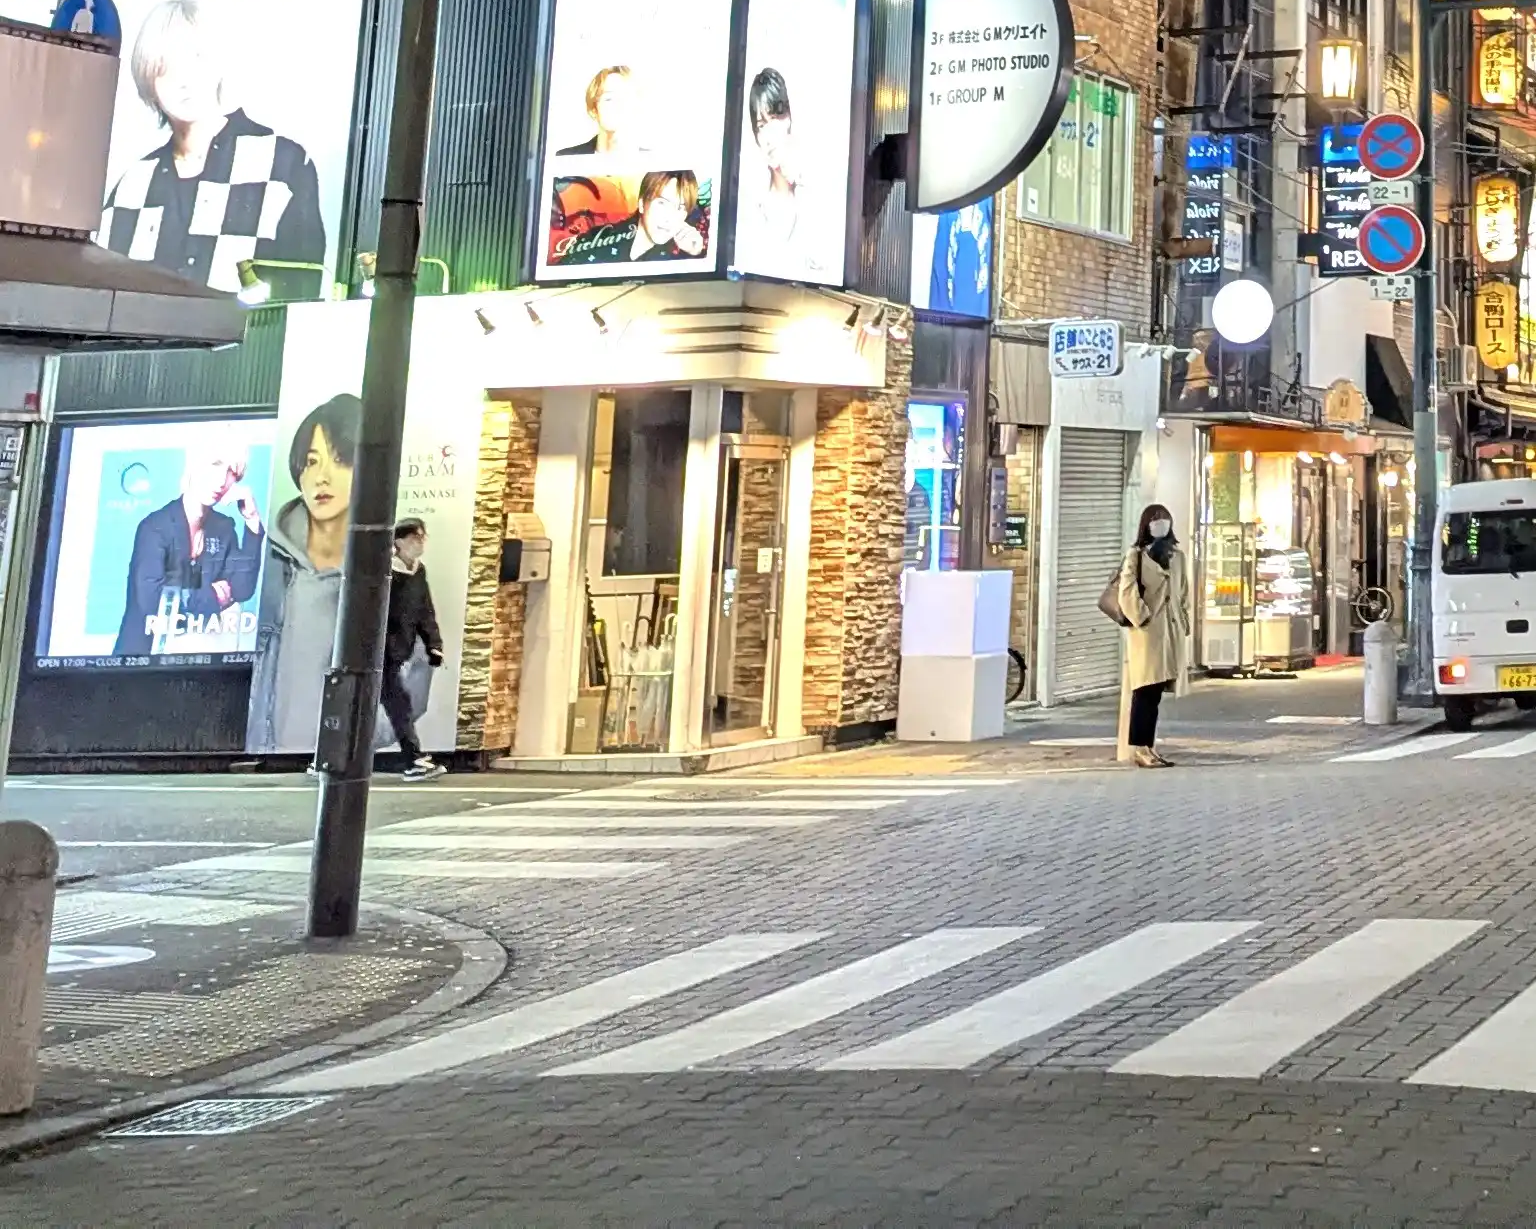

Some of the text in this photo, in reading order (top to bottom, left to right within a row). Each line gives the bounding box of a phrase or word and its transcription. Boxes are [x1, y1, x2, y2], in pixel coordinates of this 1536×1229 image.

[930, 31, 945, 45] 3F
[948, 30, 981, 44] 株式会社
[930, 53, 1050, 75] 2F GM PHOTO STUDIO
[929, 85, 1005, 106] 1F GROUP M
[552, 223, 639, 259] Richard
[1332, 250, 1368, 268] REX
[1483, 291, 1507, 355] 合鴨ロース
[1053, 326, 1115, 355] 店舗のことなら
[144, 612, 257, 636] RICHARD
[37, 658, 60, 668] OPEN
